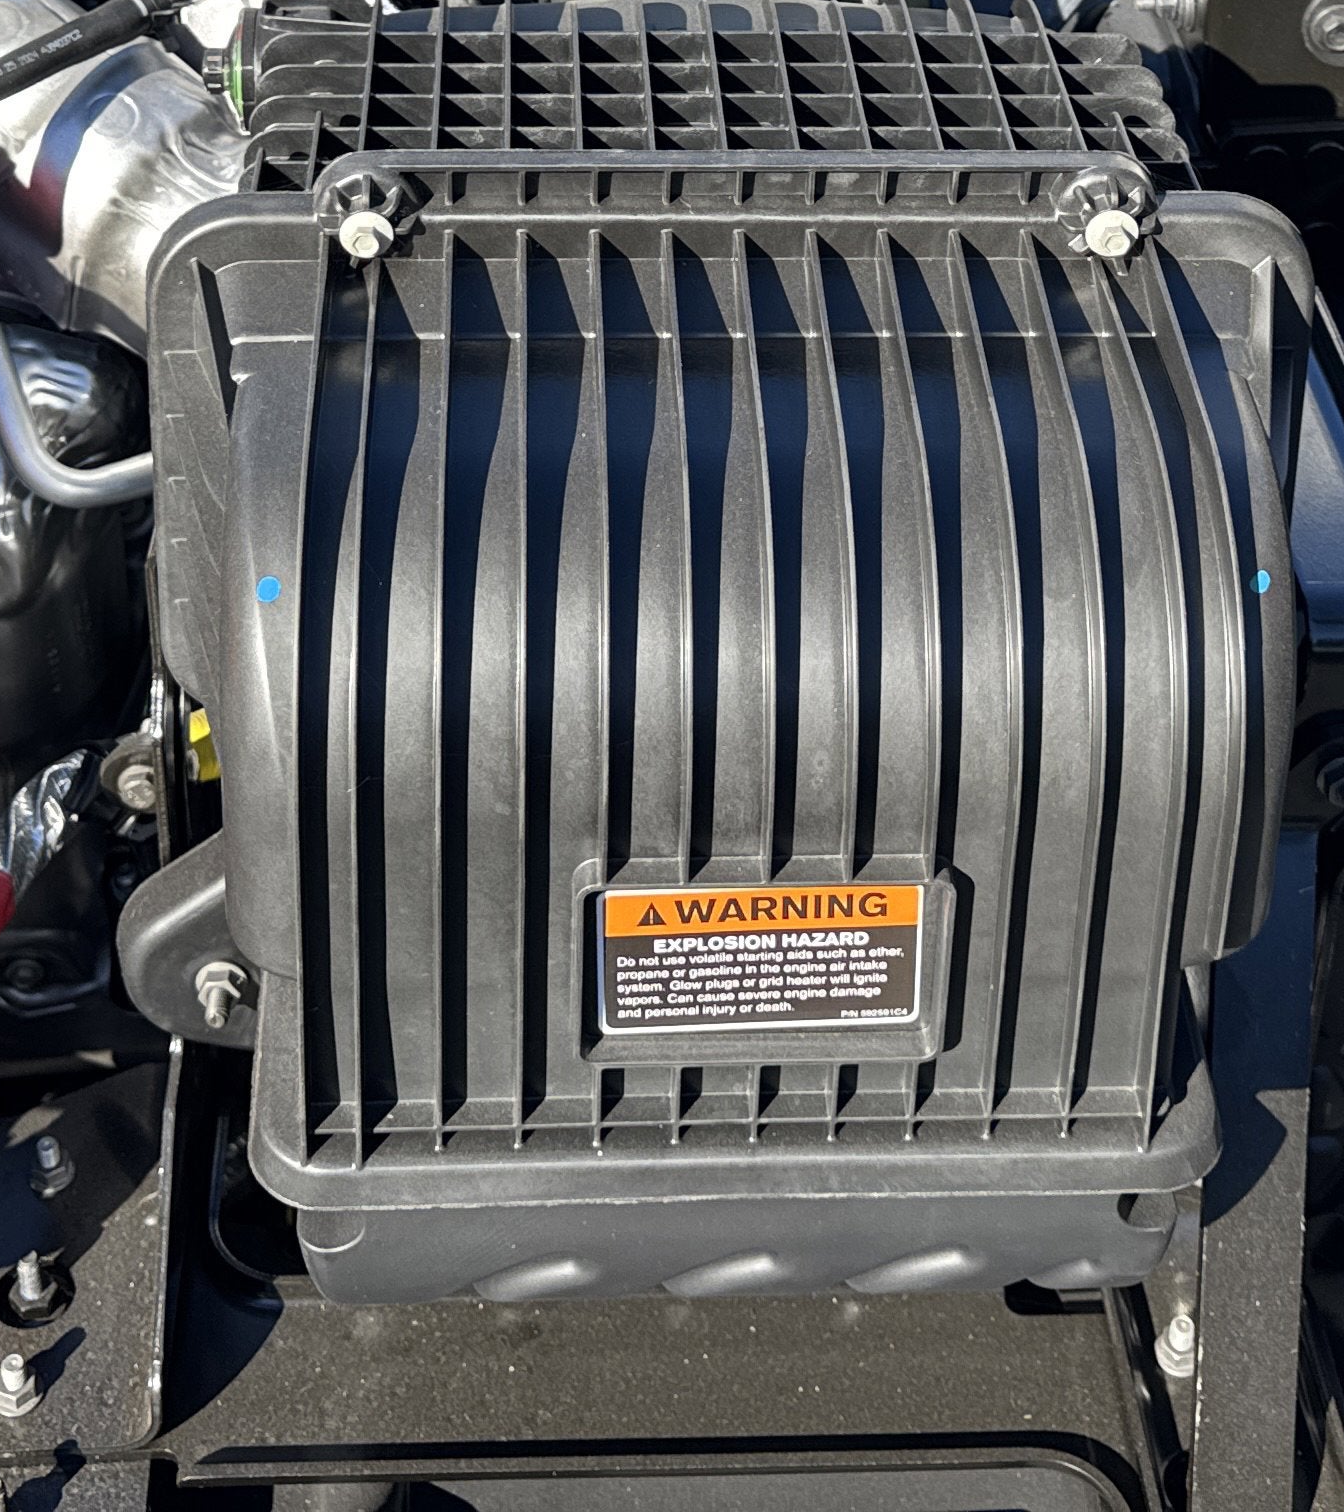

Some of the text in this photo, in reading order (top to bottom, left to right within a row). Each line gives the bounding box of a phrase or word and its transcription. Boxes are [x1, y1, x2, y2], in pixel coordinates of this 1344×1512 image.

[674, 892, 888, 924] WARNING
[653, 931, 870, 954] EXPLOSION HAZARD
[616, 946, 905, 968] Do not use volatile starting aids such as ether,
[616, 959, 888, 983] propane or gasoline in the engine air intake
[616, 972, 888, 995] system. Glow plugs or grid heater will ignite
[616, 985, 882, 1007] vapors. Can cause severe engine damage
[617, 1000, 795, 1020] and personal injury or death.
